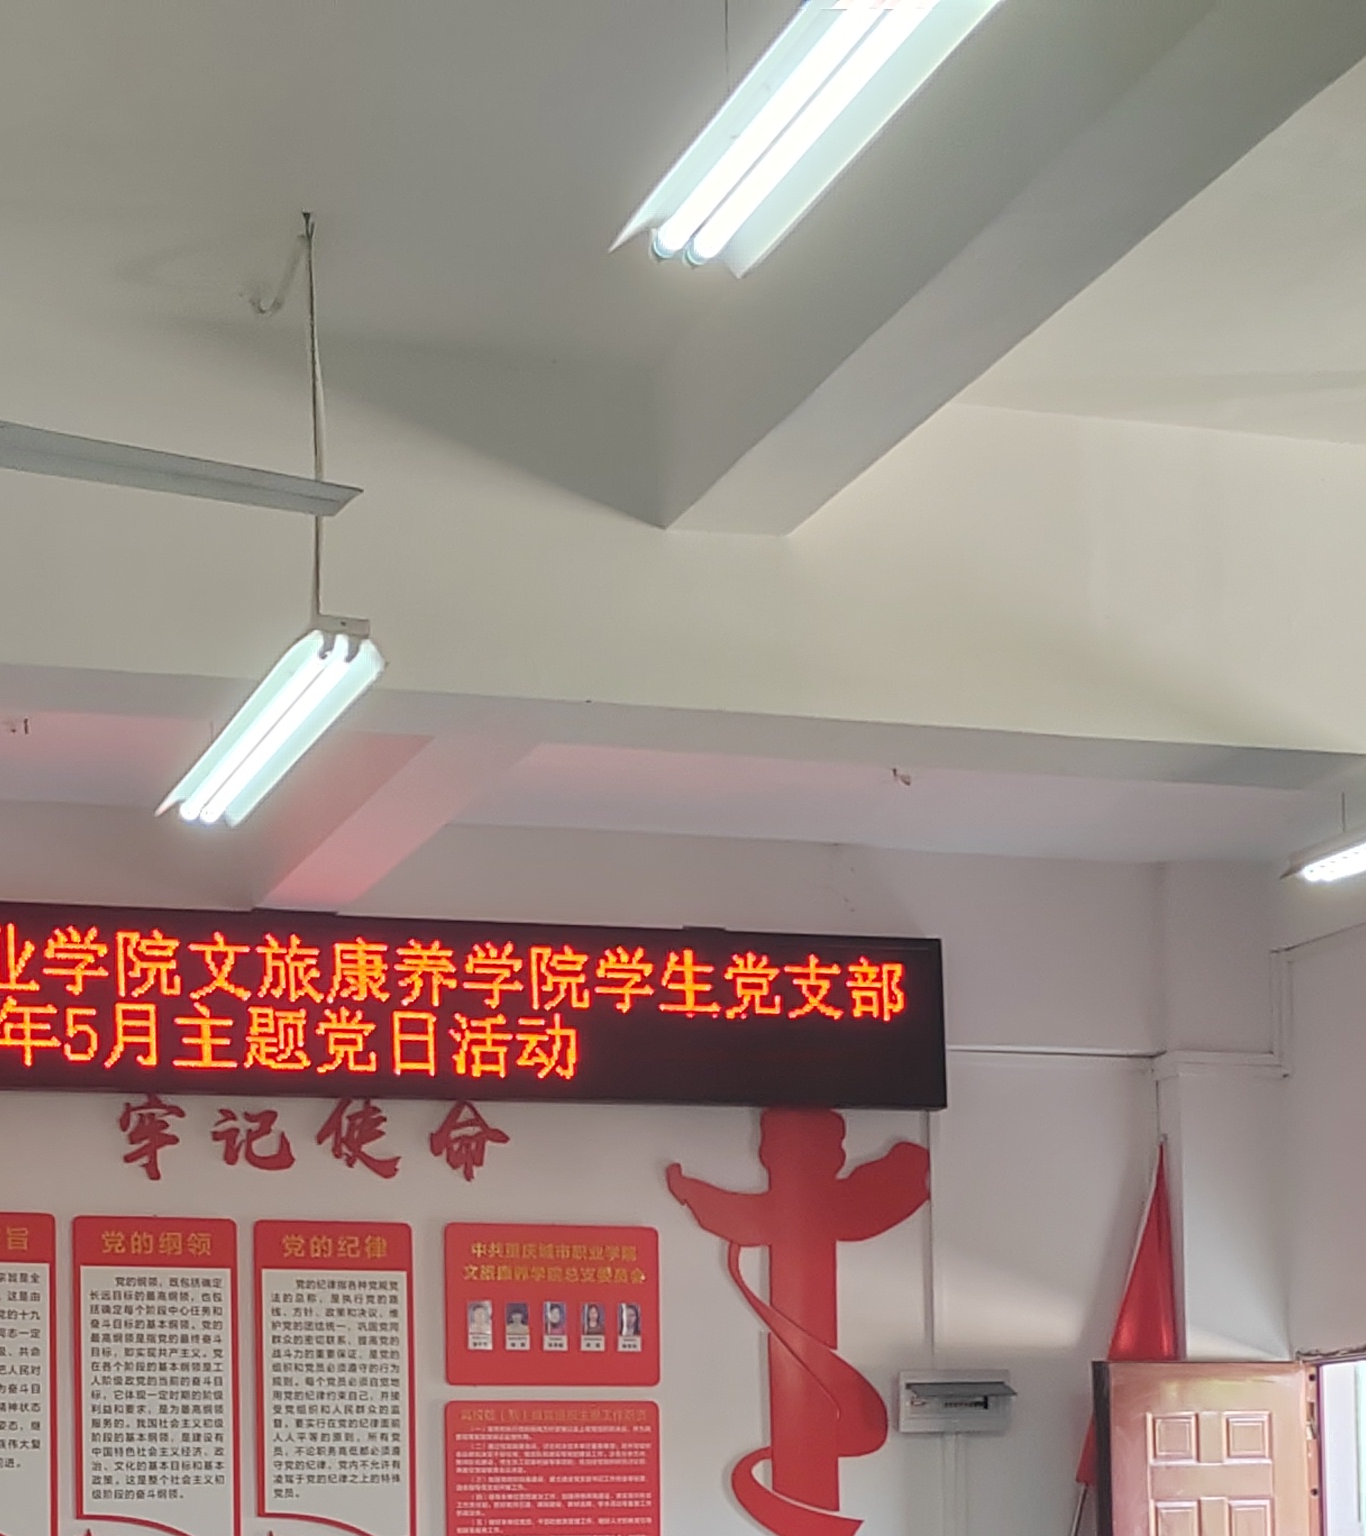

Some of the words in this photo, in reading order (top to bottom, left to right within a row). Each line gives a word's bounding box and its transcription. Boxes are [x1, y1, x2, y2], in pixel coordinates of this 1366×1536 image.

[118, 1096, 511, 1181] 牢记使命
[102, 1231, 211, 1256] 党的纲领
[282, 1234, 387, 1259] 党的纪律
